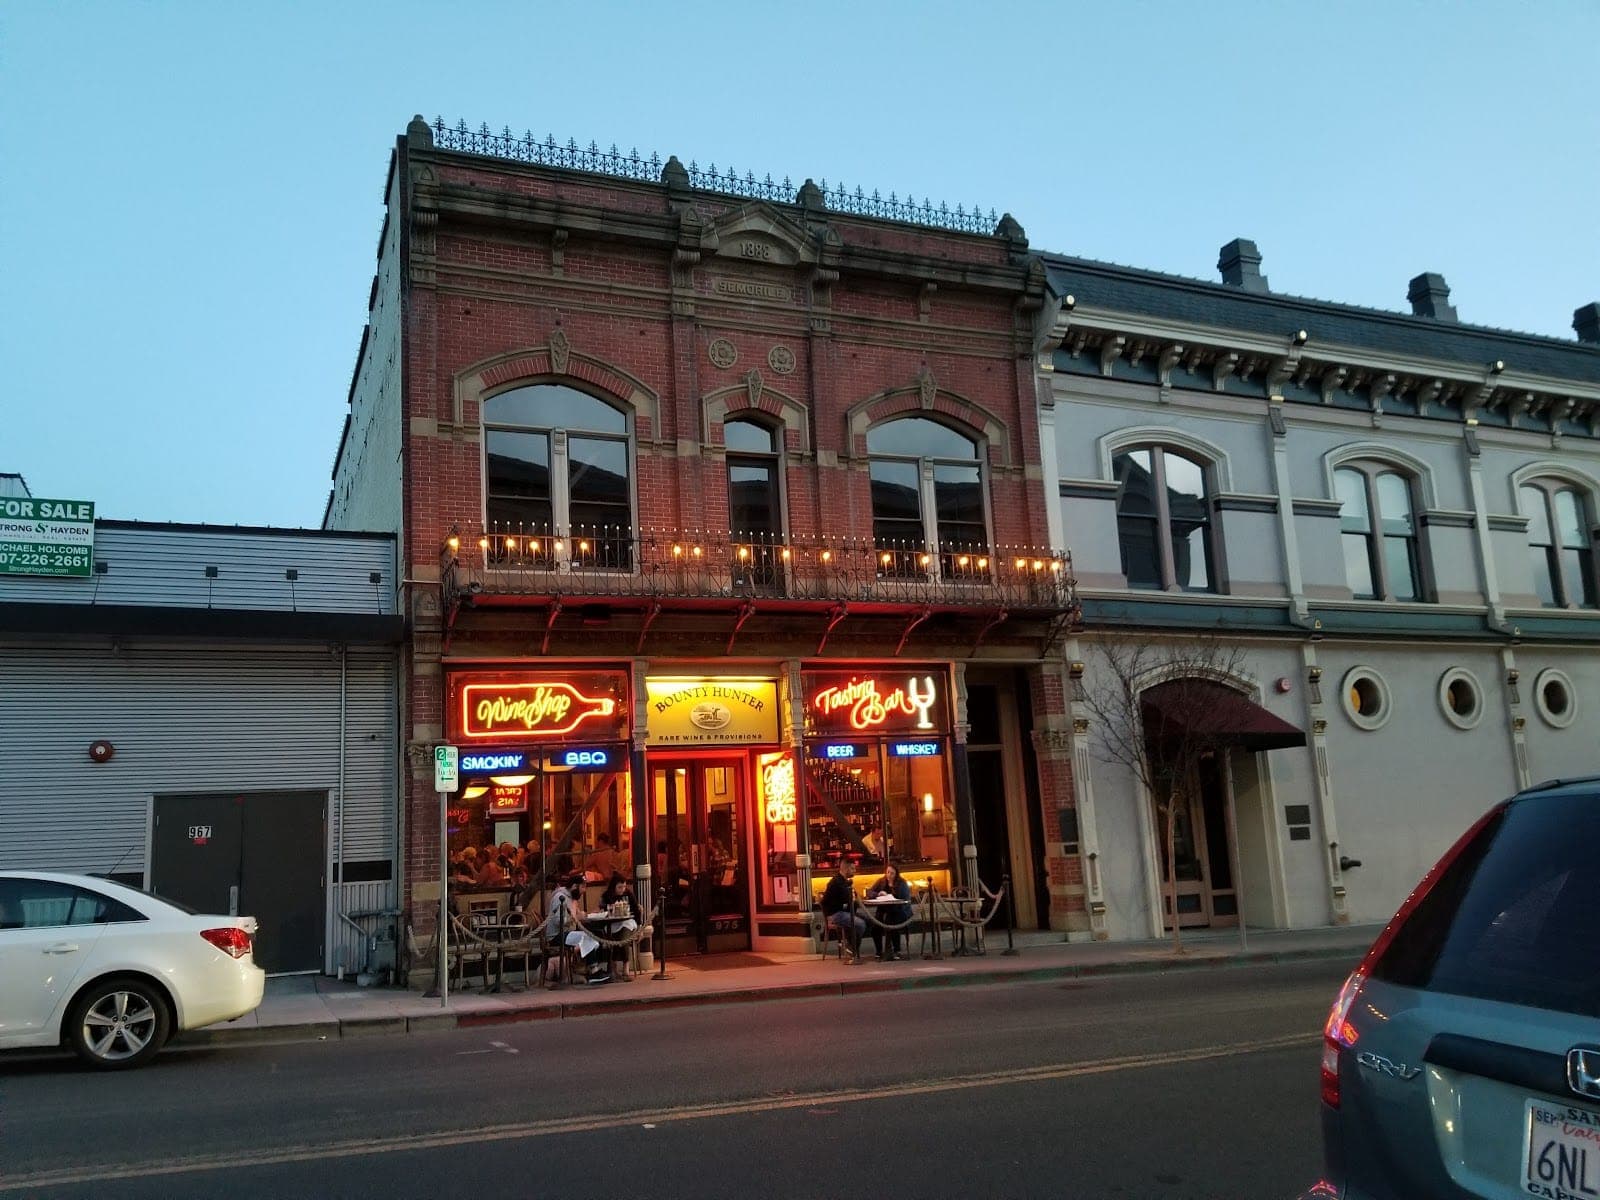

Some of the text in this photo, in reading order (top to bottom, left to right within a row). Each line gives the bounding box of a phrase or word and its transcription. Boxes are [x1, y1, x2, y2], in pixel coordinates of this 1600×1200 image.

[740, 240, 770, 259] 1888
[40, 502, 90, 520] SALE
[50, 526, 89, 535] HAYDEN
[38, 545, 88, 555] HOLCOMB
[655, 686, 764, 714] BOUNTY HUNTER
[815, 677, 916, 729] Tasting Bar
[477, 686, 571, 729] Wine Shop
[827, 745, 854, 757] BEER
[895, 744, 937, 755] WHISKEY
[462, 755, 523, 770] SMOKIN'
[565, 751, 607, 765] BBQ
[190, 826, 210, 838] 967
